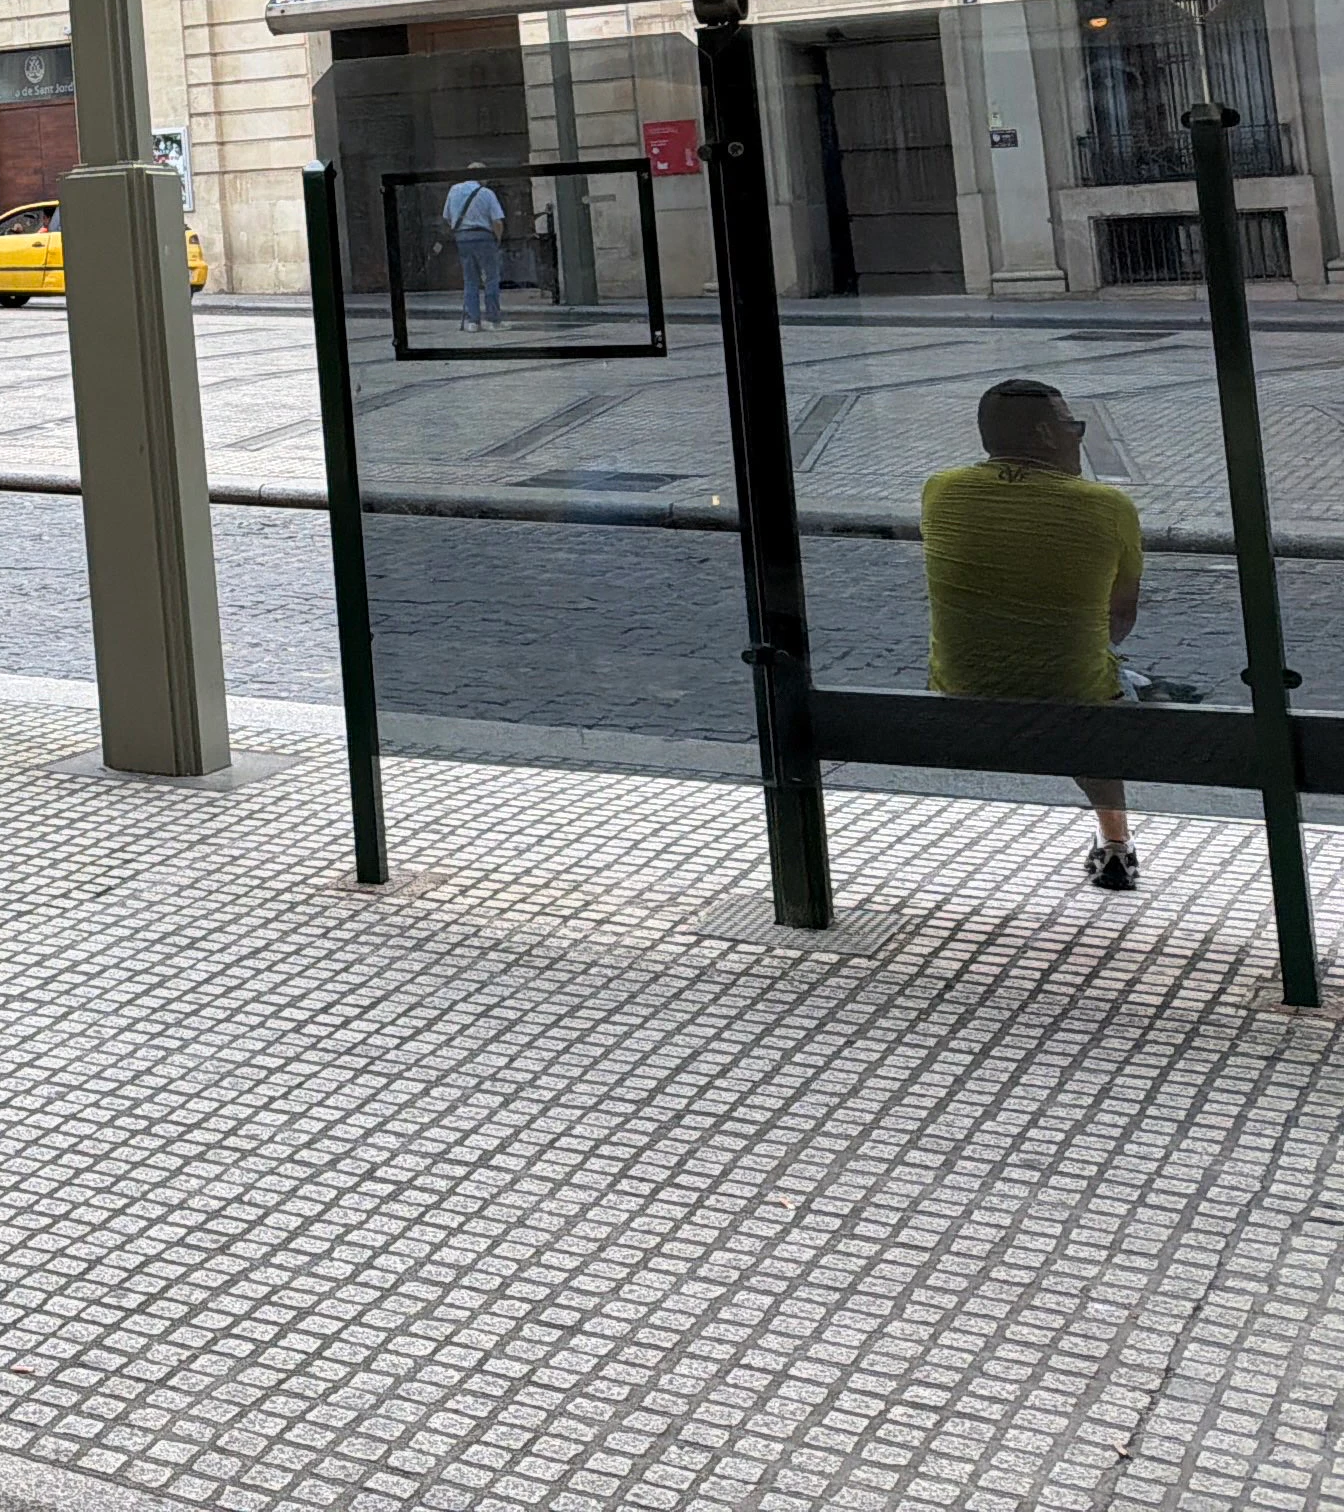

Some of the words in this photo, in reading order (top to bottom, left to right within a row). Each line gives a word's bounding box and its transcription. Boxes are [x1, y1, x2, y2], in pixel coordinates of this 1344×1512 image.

[22, 86, 32, 96] de
[34, 84, 54, 96] Sant
[55, 81, 74, 94] Jord
